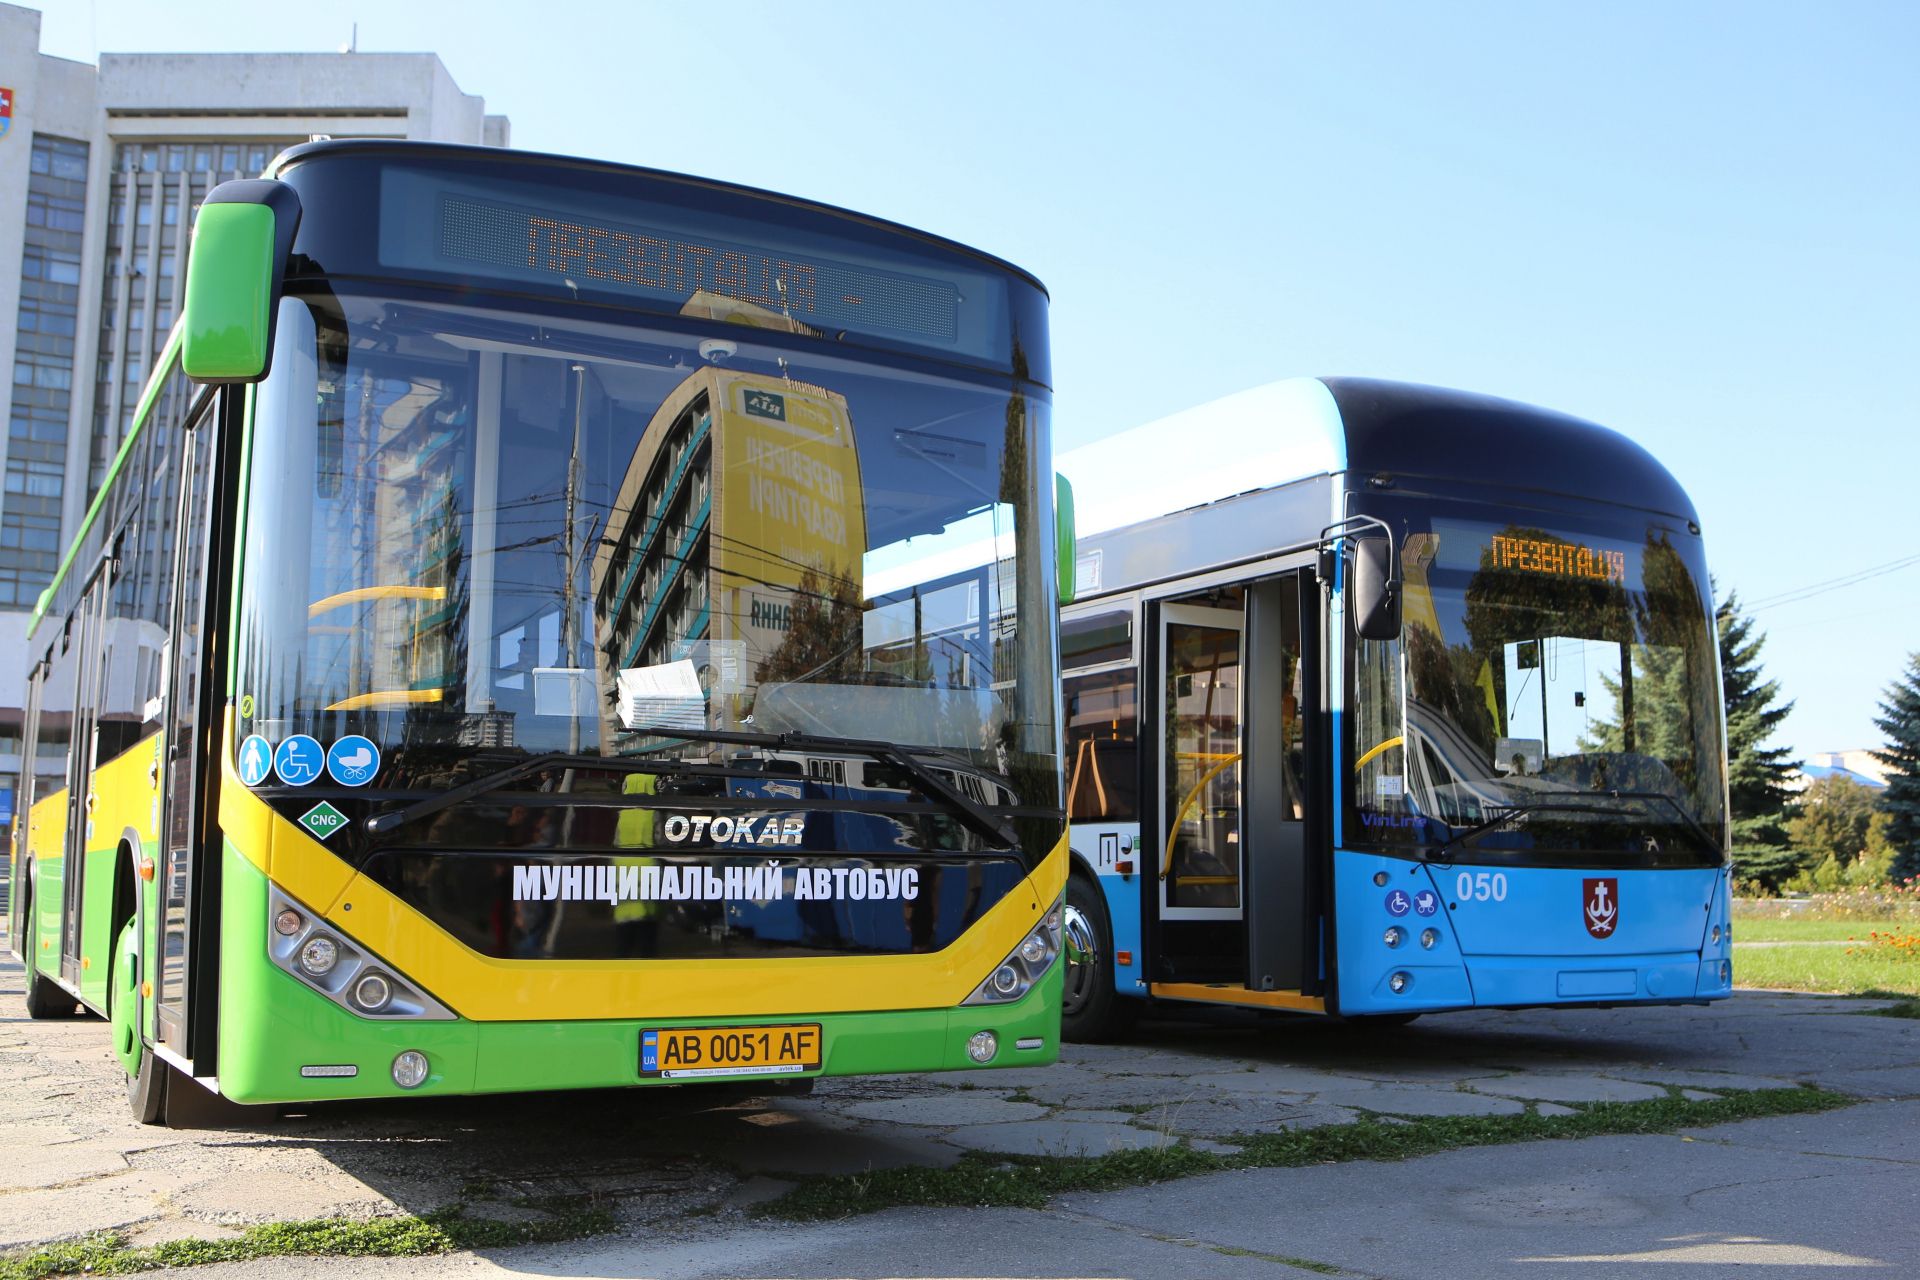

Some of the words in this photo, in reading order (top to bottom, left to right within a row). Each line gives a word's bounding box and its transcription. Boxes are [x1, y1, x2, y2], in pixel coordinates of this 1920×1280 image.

[529, 217, 816, 314] ПРЕЗЕНТАЦІЯ
[1492, 535, 1625, 583] ПРЕЗЕНТАЦІЯ
[310, 814, 337, 826] CNG
[664, 816, 805, 844] OTOKAR
[1361, 812, 1428, 828] VinLine
[513, 860, 783, 905] МУНІЦИПАЛЬНИЙ
[794, 867, 919, 900] АВТОБУС
[1456, 872, 1508, 901] 050
[643, 1056, 656, 1065] UA
[664, 1036, 702, 1064] AB
[710, 1033, 769, 1062] 0051
[779, 1031, 814, 1060] AF
